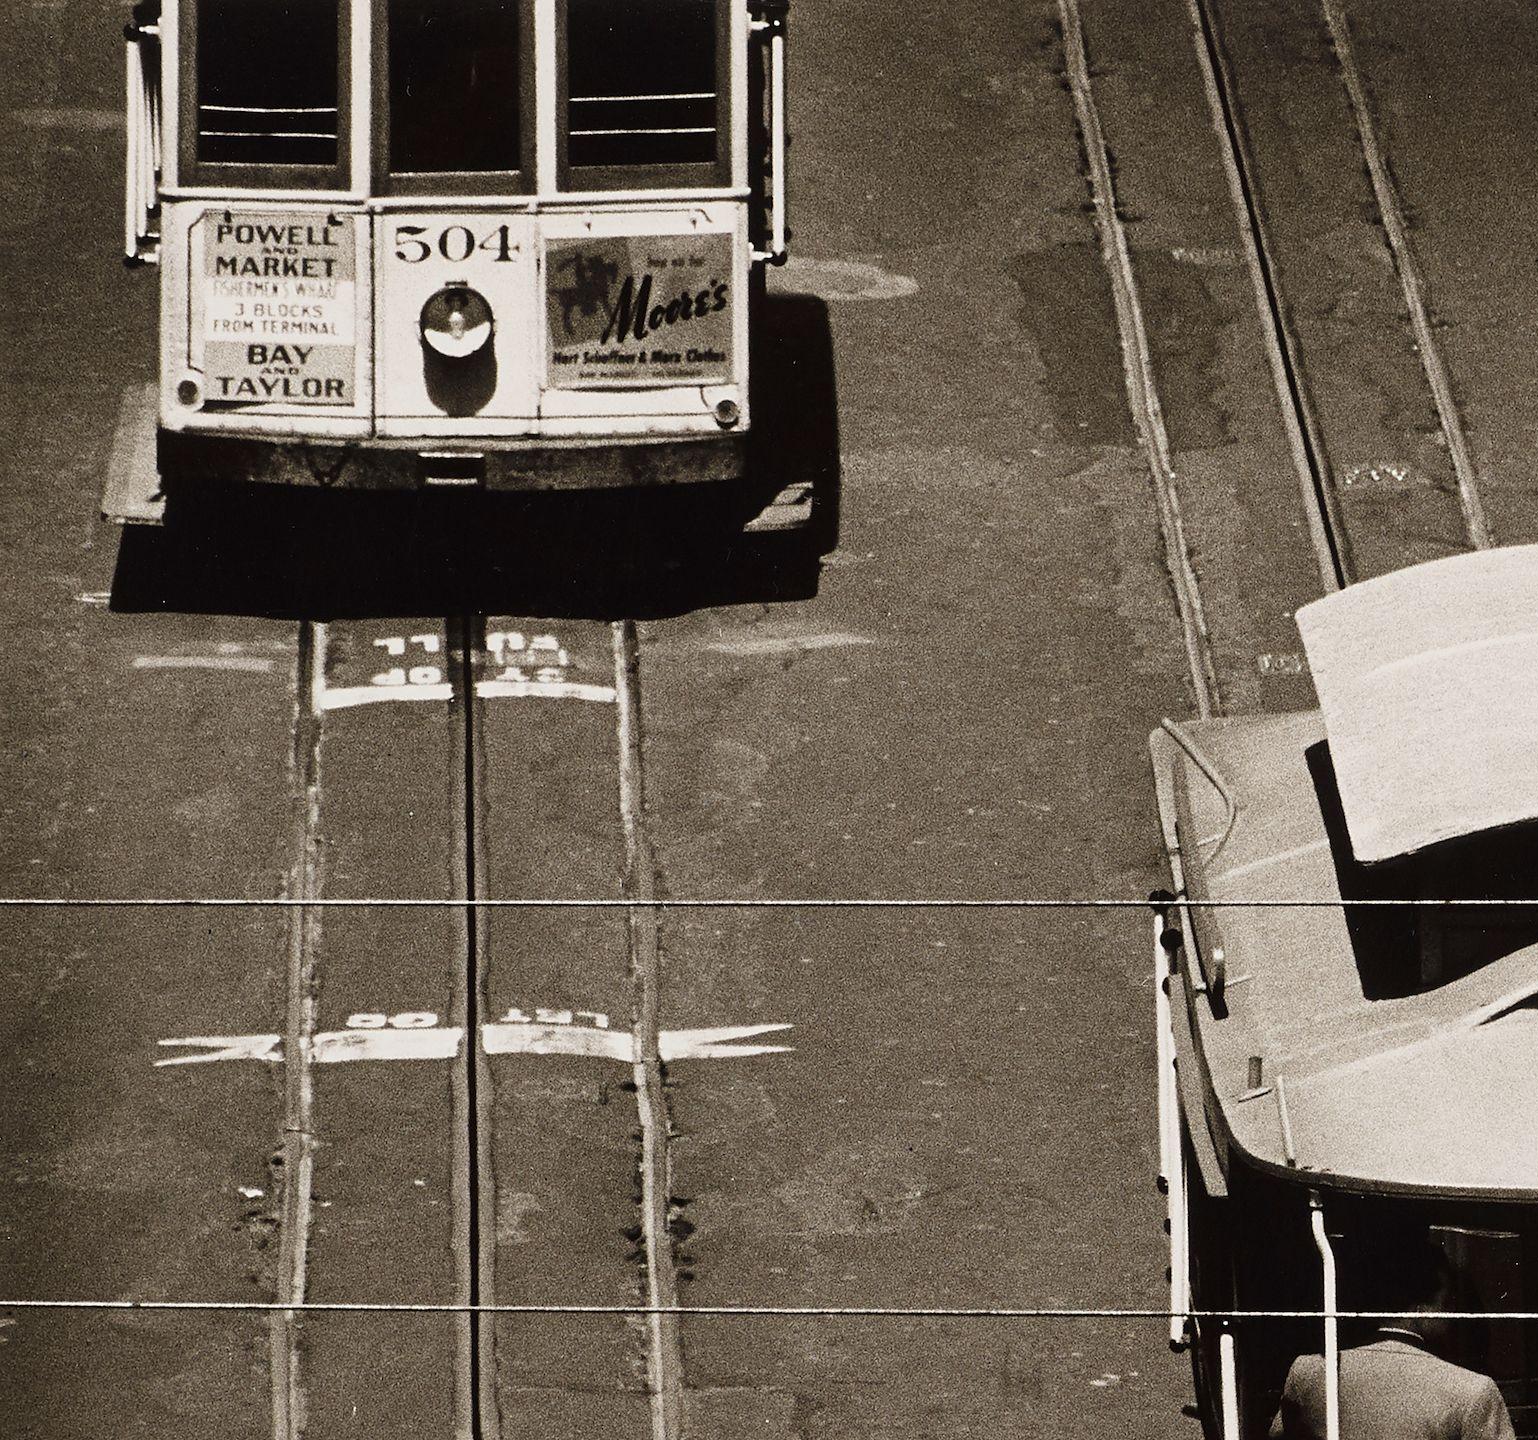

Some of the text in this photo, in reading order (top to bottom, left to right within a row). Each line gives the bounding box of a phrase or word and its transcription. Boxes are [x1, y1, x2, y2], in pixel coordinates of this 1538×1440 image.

[217, 224, 339, 246] POWELL
[395, 224, 520, 264] 504
[261, 247, 298, 255] AND
[215, 256, 337, 278] MARKET
[254, 303, 323, 318] BLOCKS
[600, 274, 728, 345] Moore's
[213, 319, 339, 336] FROM TERMINAL
[248, 344, 313, 365] BAY
[261, 367, 299, 376] AND
[215, 376, 345, 398] TAYLOR
